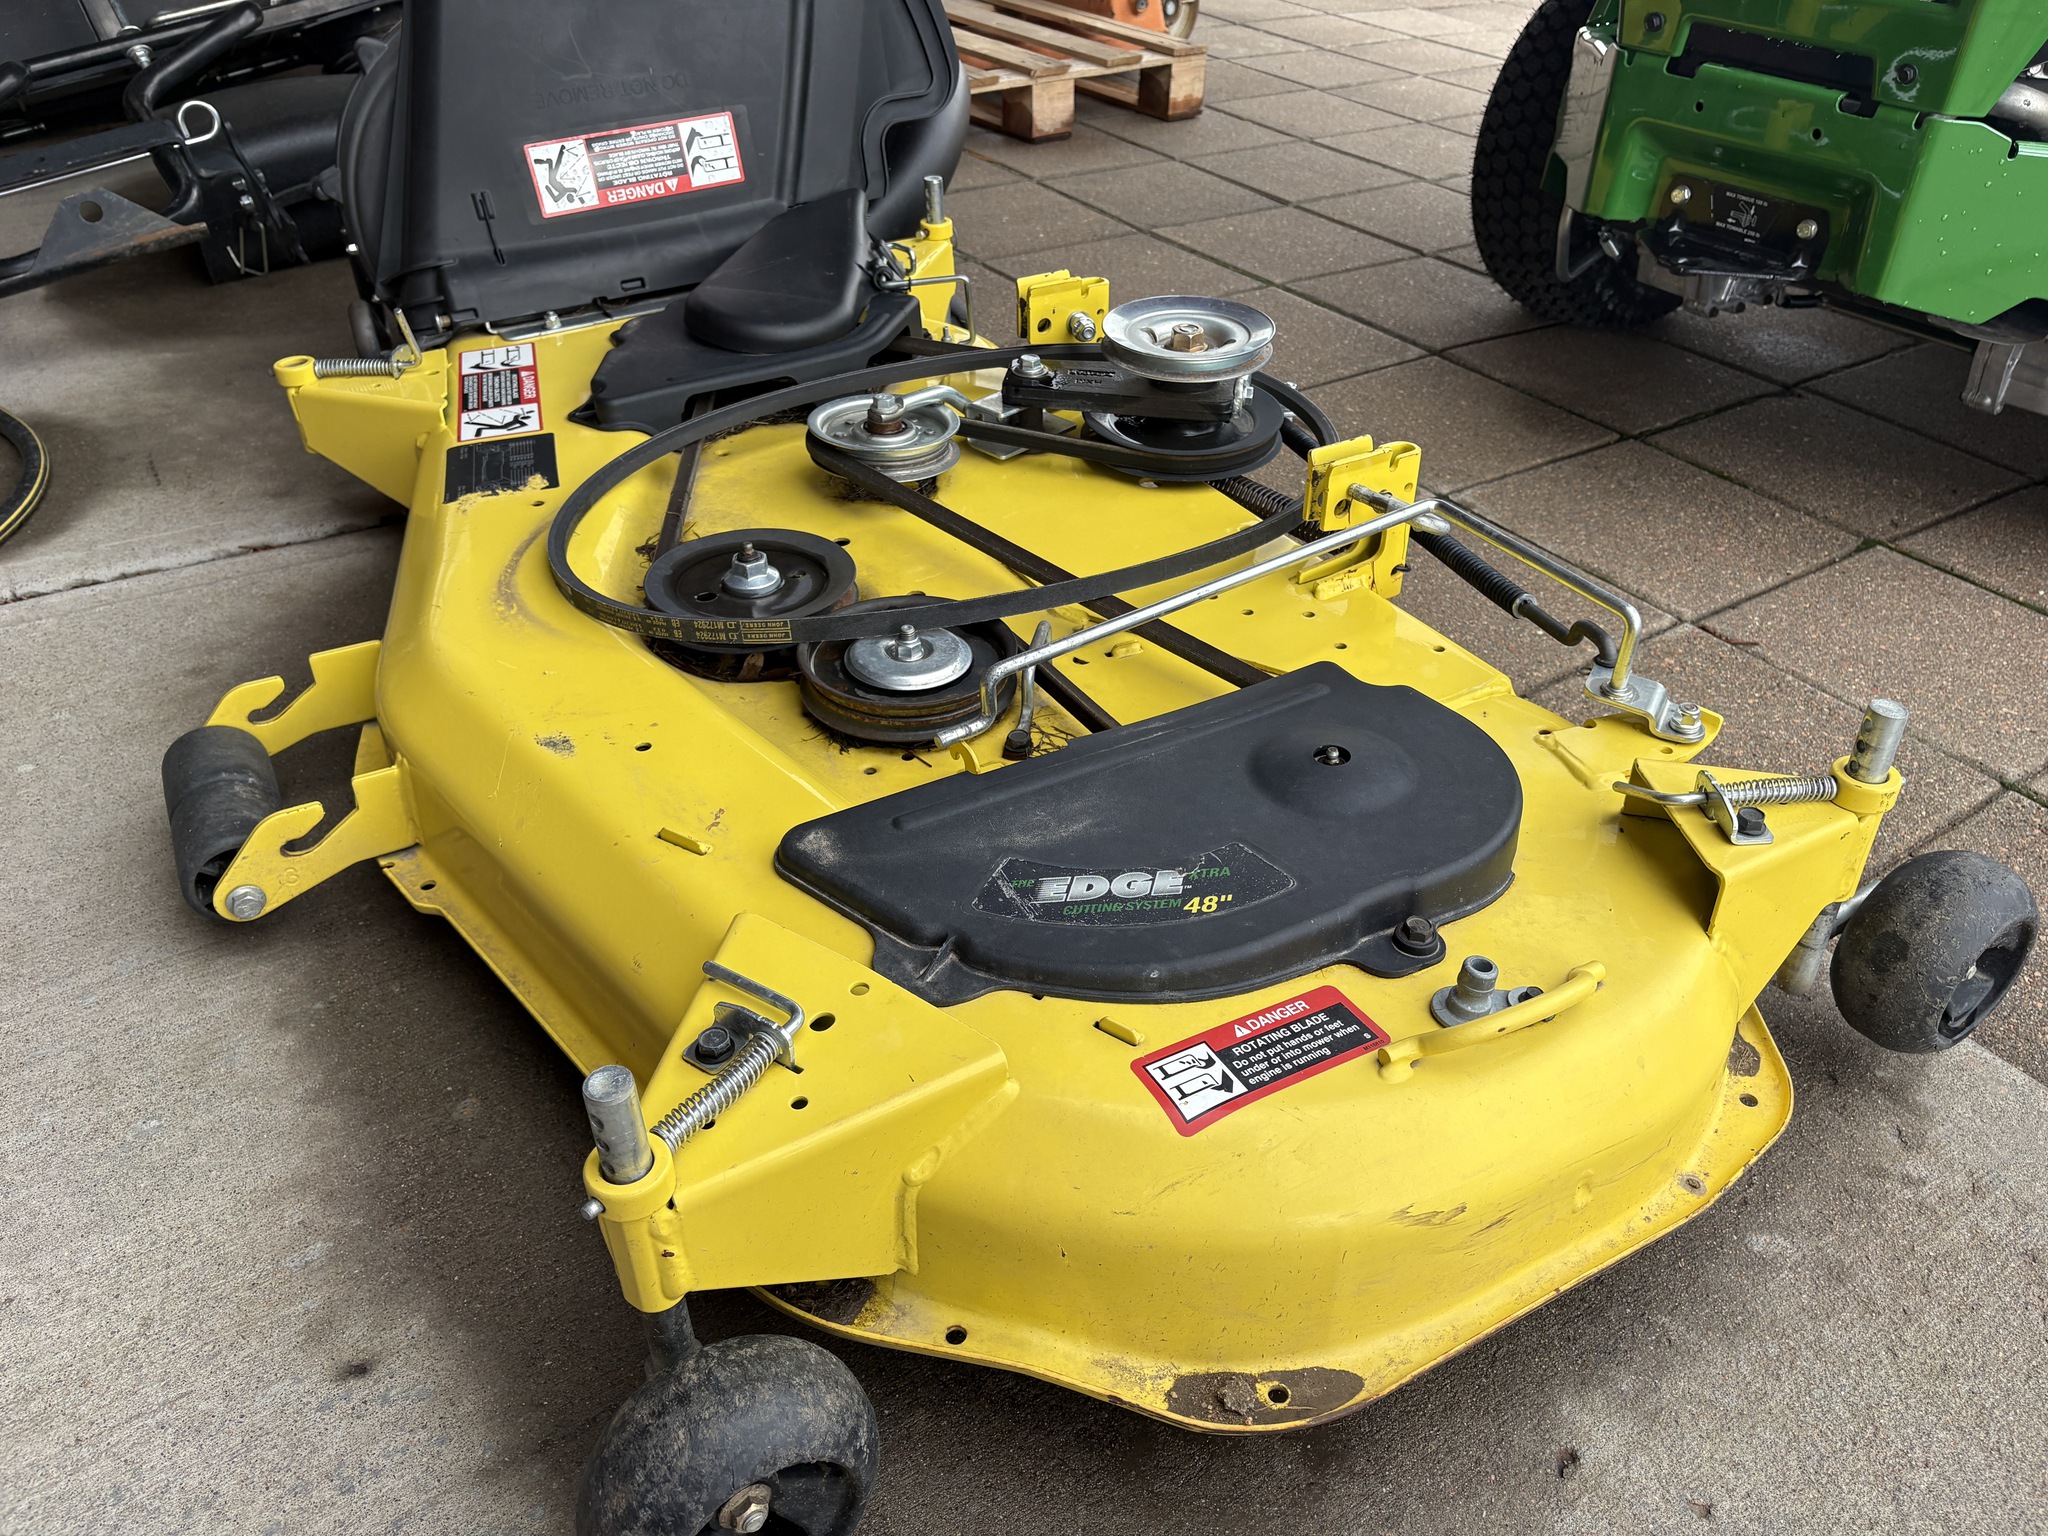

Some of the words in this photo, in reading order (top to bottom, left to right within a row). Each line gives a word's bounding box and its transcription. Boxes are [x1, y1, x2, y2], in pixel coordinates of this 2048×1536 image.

[533, 83, 612, 108] REMOVE
[619, 77, 657, 96] NOT
[662, 74, 687, 90] DO
[607, 182, 664, 202] DANGER
[523, 376, 537, 400] DANGER
[1011, 879, 1035, 888] THE
[1030, 869, 1184, 903] EDGE
[1063, 901, 1123, 915] CUTTING
[1126, 898, 1182, 912] SYSTEM
[1183, 894, 1233, 914] 48"
[1246, 1000, 1309, 1029] DANGER
[1232, 1029, 1291, 1055] ROTATING
[1290, 1013, 1329, 1032] BLADE
[1232, 1059, 1248, 1068] Do
[1249, 1051, 1267, 1062] not
[1266, 1044, 1284, 1056] put
[1282, 1033, 1313, 1048] hands
[1323, 1020, 1344, 1031] feet
[1241, 1061, 1269, 1076] under
[1270, 1056, 1281, 1064] or
[1281, 1048, 1302, 1059] into
[1302, 1034, 1333, 1051] mower
[1333, 1024, 1359, 1037] when
[1248, 1067, 1282, 1084] engine
[1292, 1047, 1331, 1066] running
